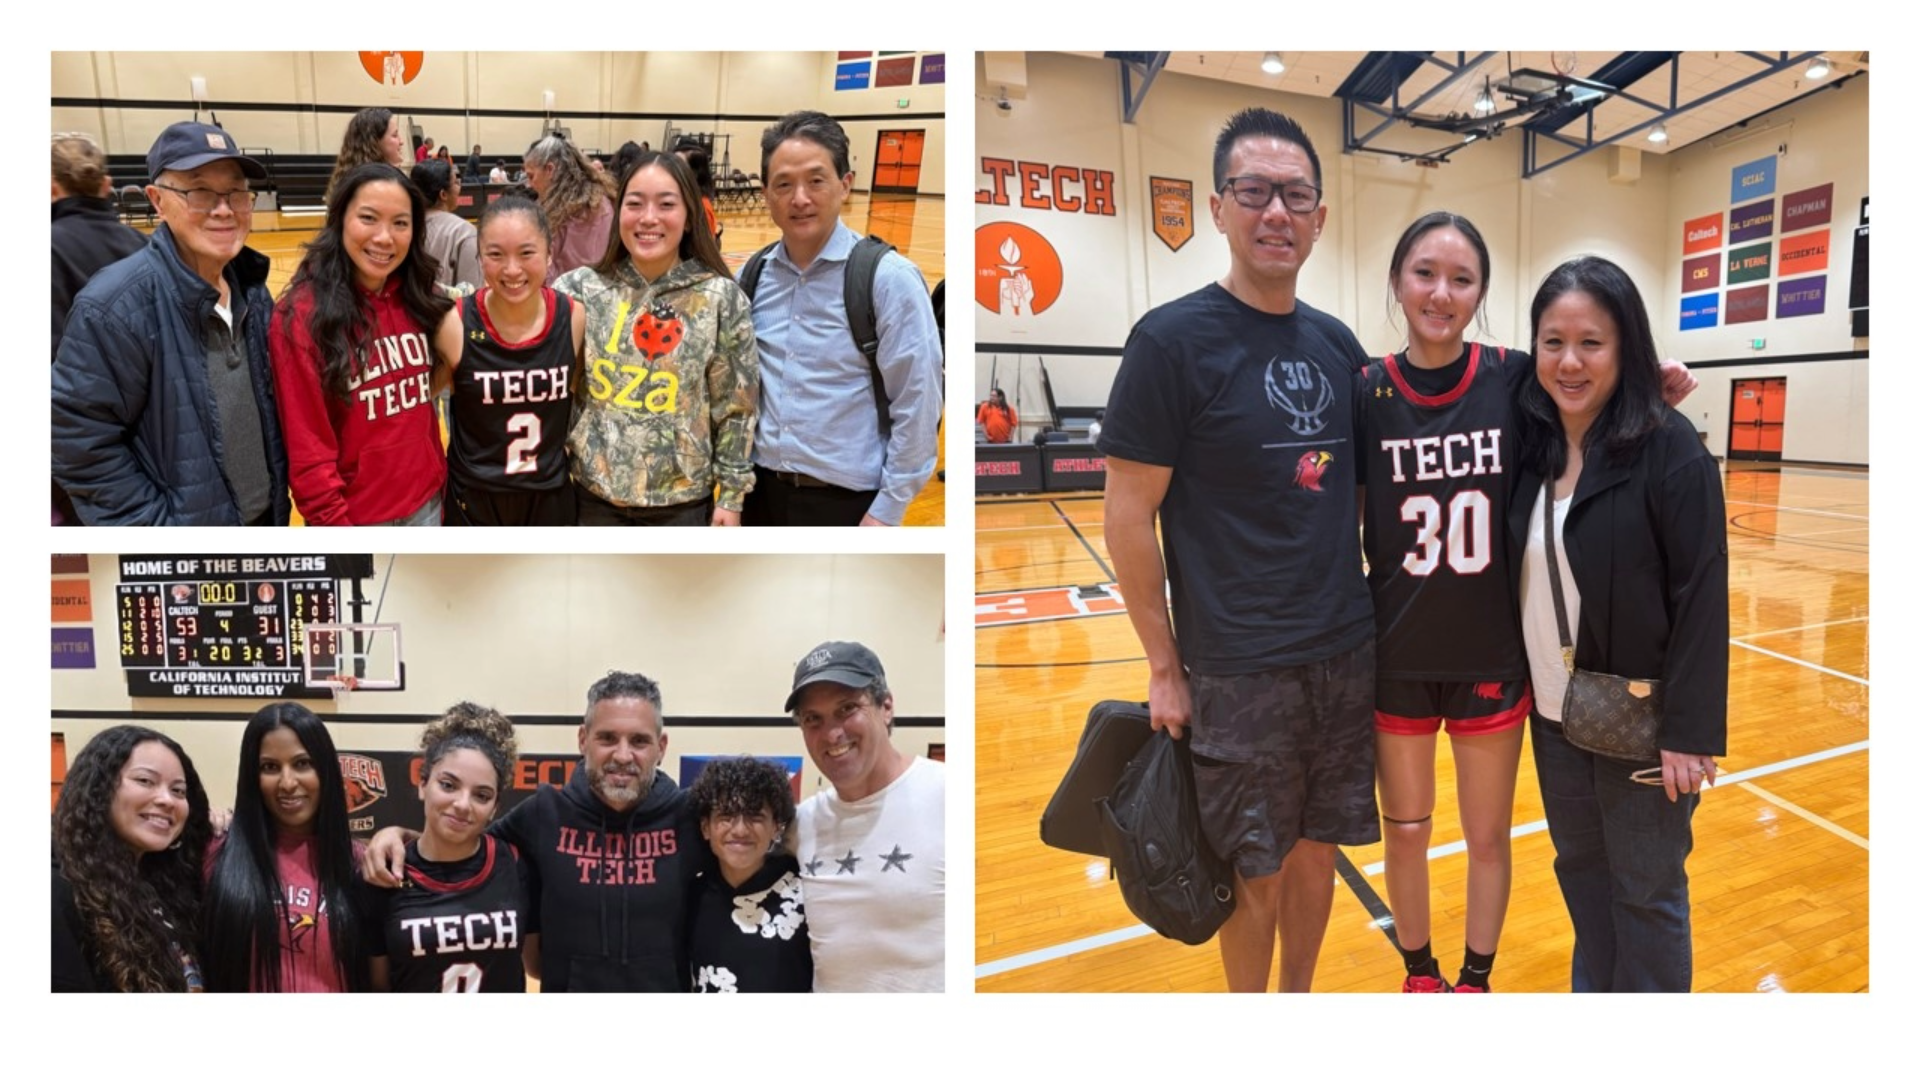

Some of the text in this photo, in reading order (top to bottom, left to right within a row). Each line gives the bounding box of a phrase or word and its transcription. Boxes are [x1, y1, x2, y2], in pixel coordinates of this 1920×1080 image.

[1741, 172, 1765, 187] SCIAC
[1787, 199, 1826, 217] CHAPMAN
[1162, 215, 1185, 227] 1954
[1742, 214, 1773, 228] LUTHERAN
[1688, 226, 1718, 242] Caltech
[1781, 246, 1826, 261] OCCIDENTAL
[1730, 255, 1768, 272] LA VERNE
[1693, 267, 1709, 280] CMS
[1781, 288, 1822, 304] WHITTIER
[1280, 361, 1314, 390] 30
[474, 365, 569, 404] TECH
[359, 371, 431, 421] TECH
[504, 412, 542, 475] 2
[1381, 428, 1503, 483] TECH
[1400, 489, 1492, 576] 30
[123, 556, 326, 576] HOME OF THE BEAVERS
[253, 605, 277, 615] GUEST
[176, 617, 198, 635] 53
[220, 620, 230, 633] 4
[259, 616, 280, 635] 31
[178, 646, 187, 660] 3
[275, 646, 284, 661] 3
[149, 671, 303, 684] CALIFORNIA INSTITUT
[173, 684, 285, 696] OF TECHNOLOGY
[556, 826, 678, 860] ILLINOIS
[576, 859, 657, 886] TECH
[400, 910, 519, 957] TECH
